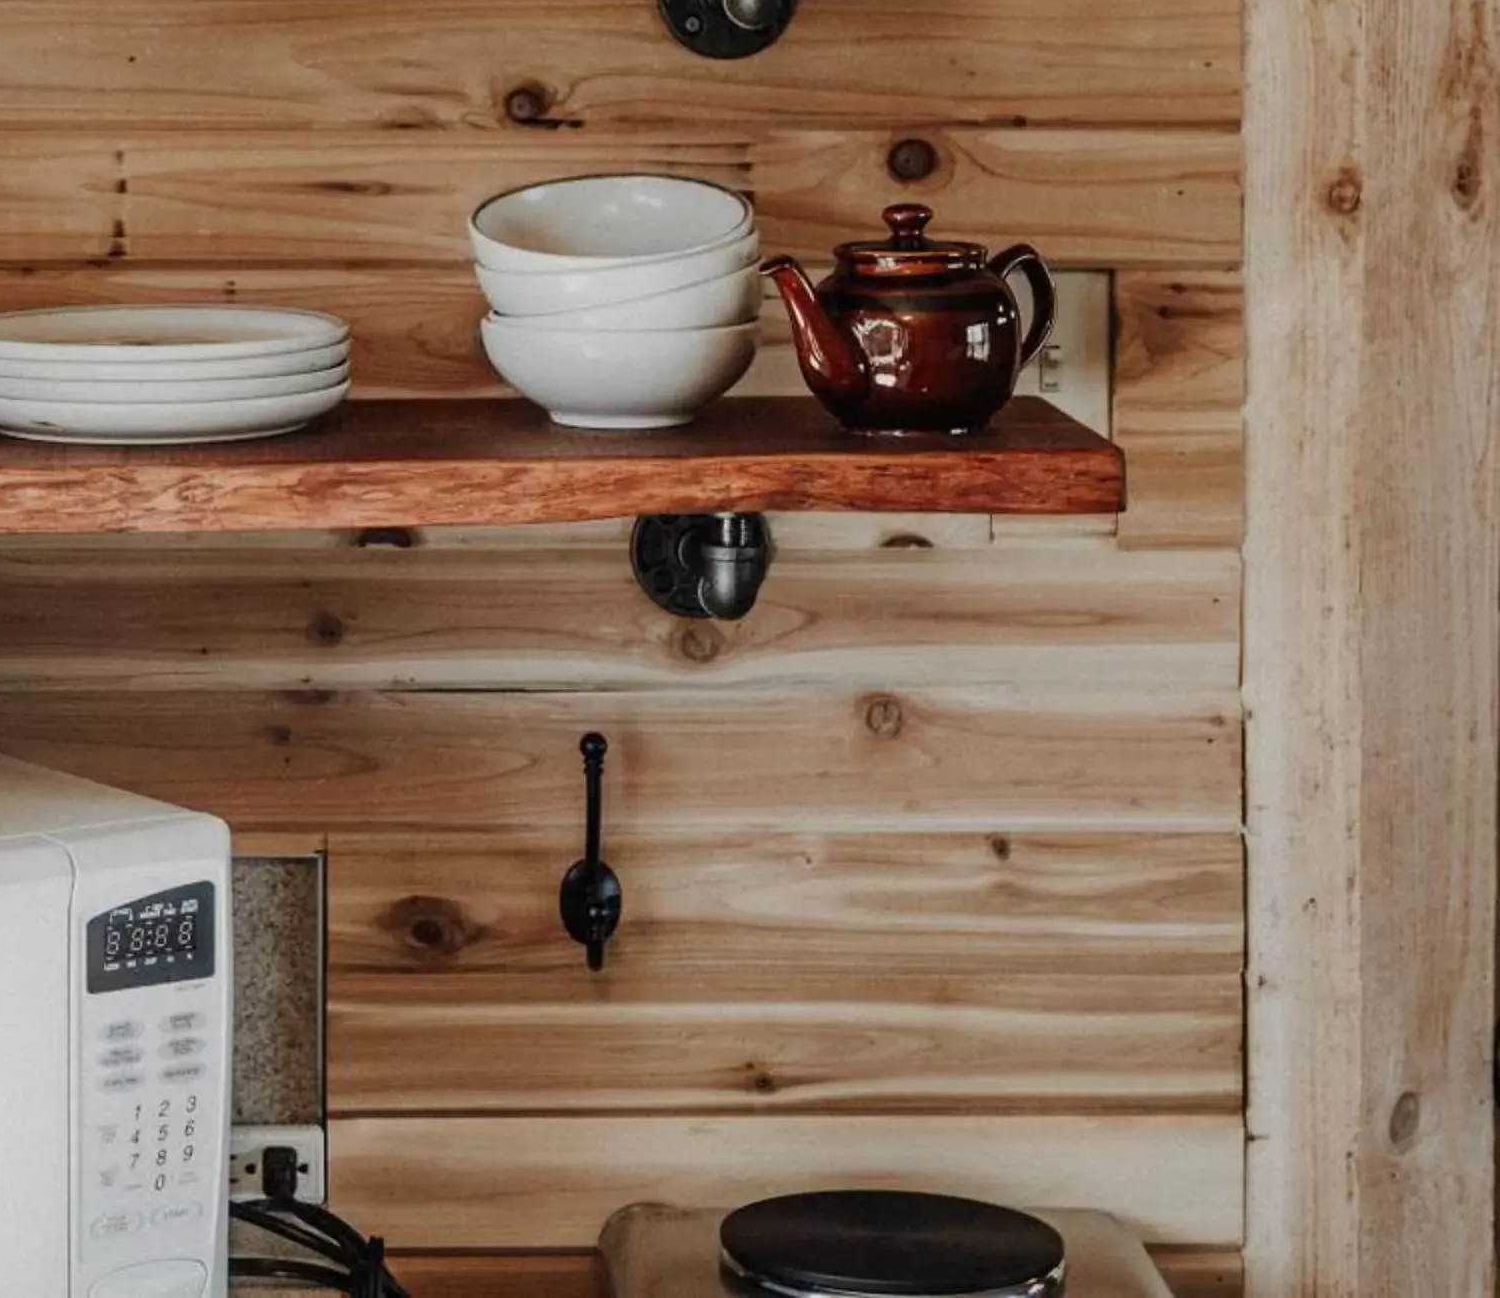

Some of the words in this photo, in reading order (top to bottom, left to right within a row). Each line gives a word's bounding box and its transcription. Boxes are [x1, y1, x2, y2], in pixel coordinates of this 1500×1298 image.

[134, 1104, 142, 1121] 1
[158, 1099, 171, 1117] 2
[185, 1094, 198, 1113] 3
[130, 1129, 141, 1144] 4
[157, 1123, 170, 1141] 5
[184, 1119, 195, 1137] 6
[129, 1152, 141, 1170] 7
[156, 1149, 167, 1166] 8
[182, 1144, 194, 1162] 9
[154, 1173, 166, 1191] 0
